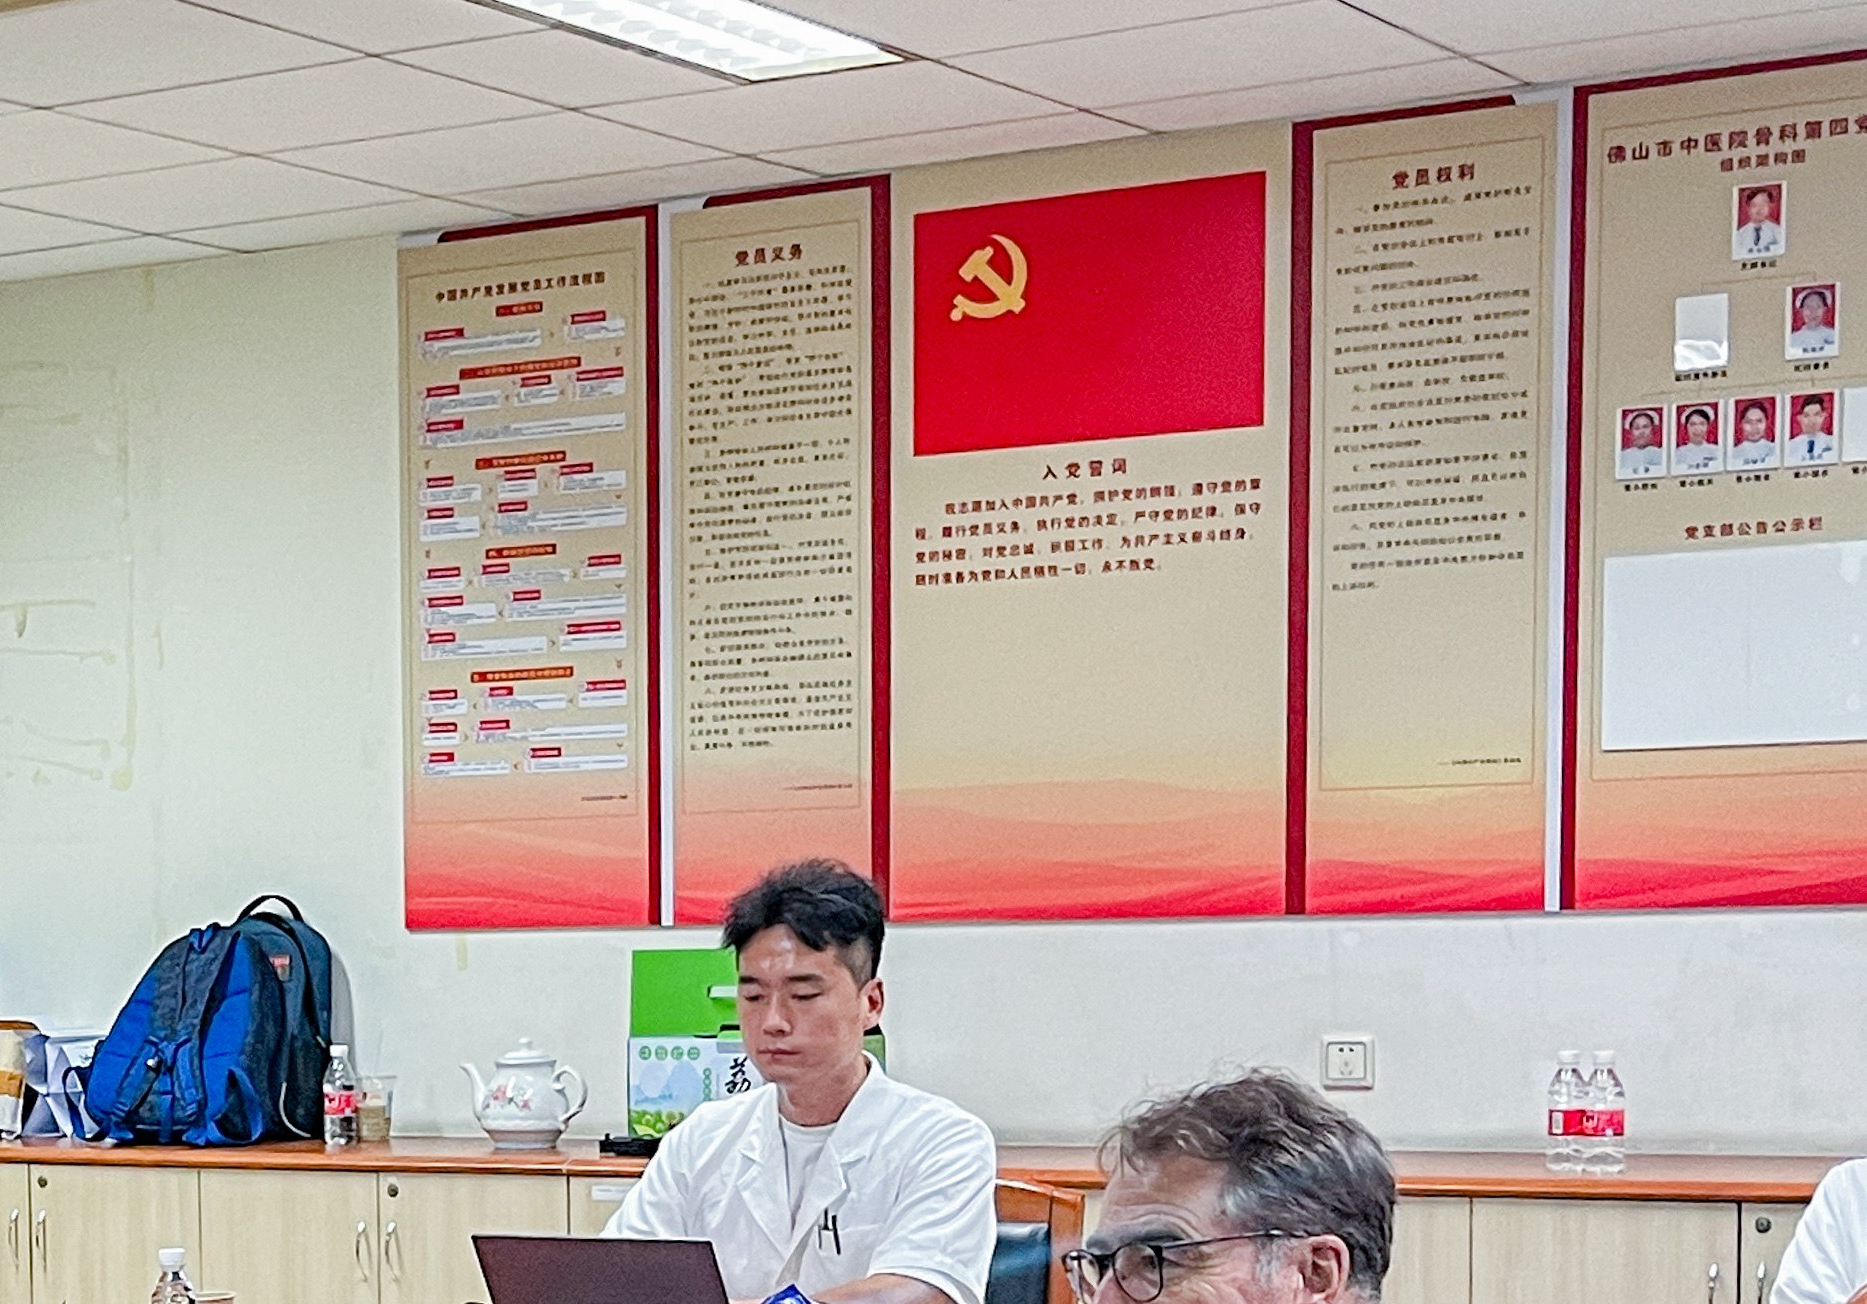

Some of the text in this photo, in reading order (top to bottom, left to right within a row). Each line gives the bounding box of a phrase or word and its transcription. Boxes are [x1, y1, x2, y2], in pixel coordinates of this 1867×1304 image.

[735, 243, 803, 267] 党员义务
[1042, 458, 1127, 481] 入党誓词
